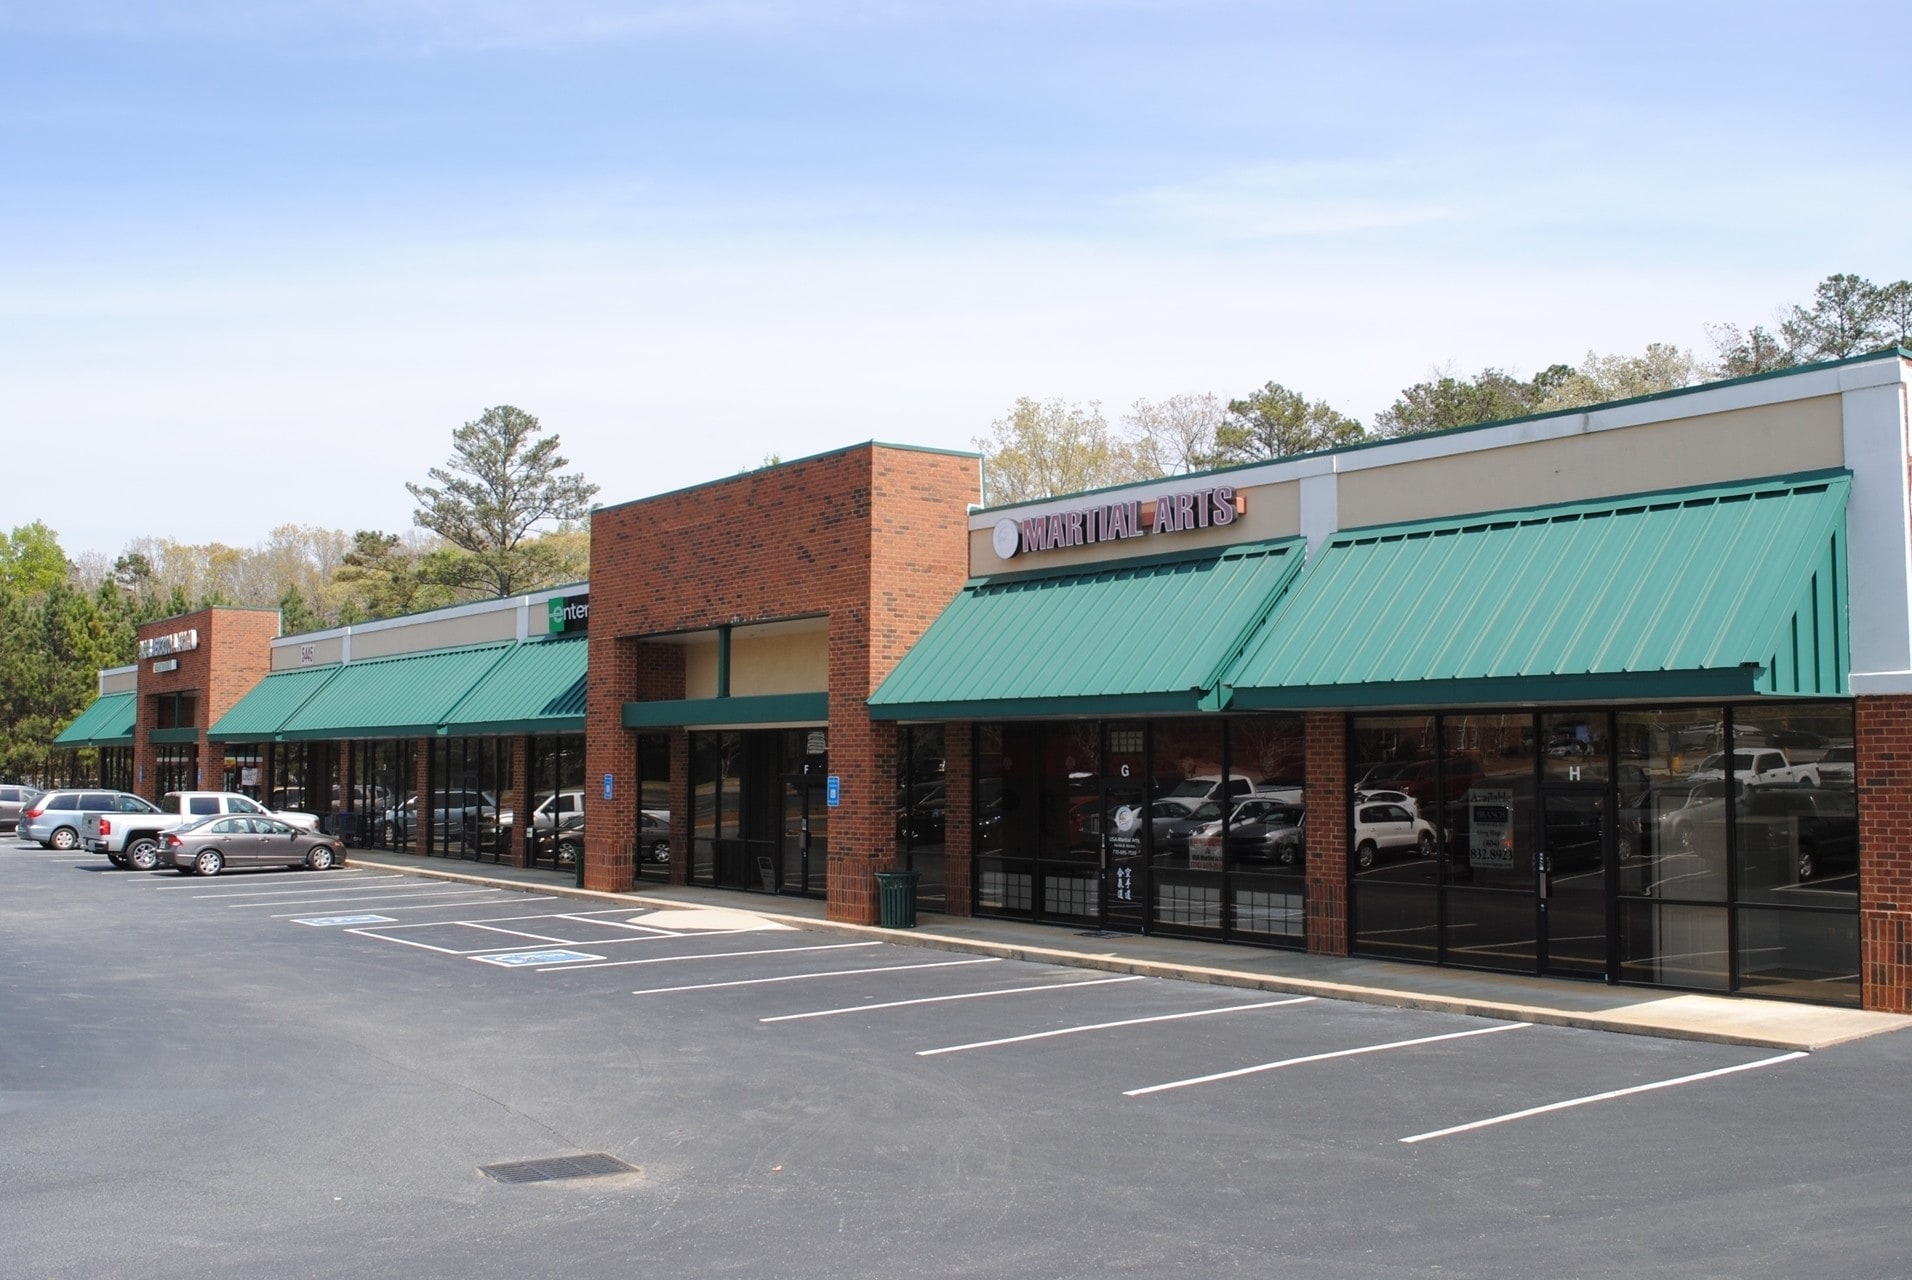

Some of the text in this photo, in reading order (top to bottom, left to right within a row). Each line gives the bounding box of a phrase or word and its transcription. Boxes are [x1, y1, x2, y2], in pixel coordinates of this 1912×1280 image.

[1021, 486, 1236, 553] MARTIAL ARTS
[550, 603, 589, 623] enter
[803, 764, 810, 775] F
[1121, 764, 1130, 777] G
[1569, 766, 1581, 781] H
[1471, 792, 1511, 803] Available
[1471, 848, 1513, 860] 832.8923
